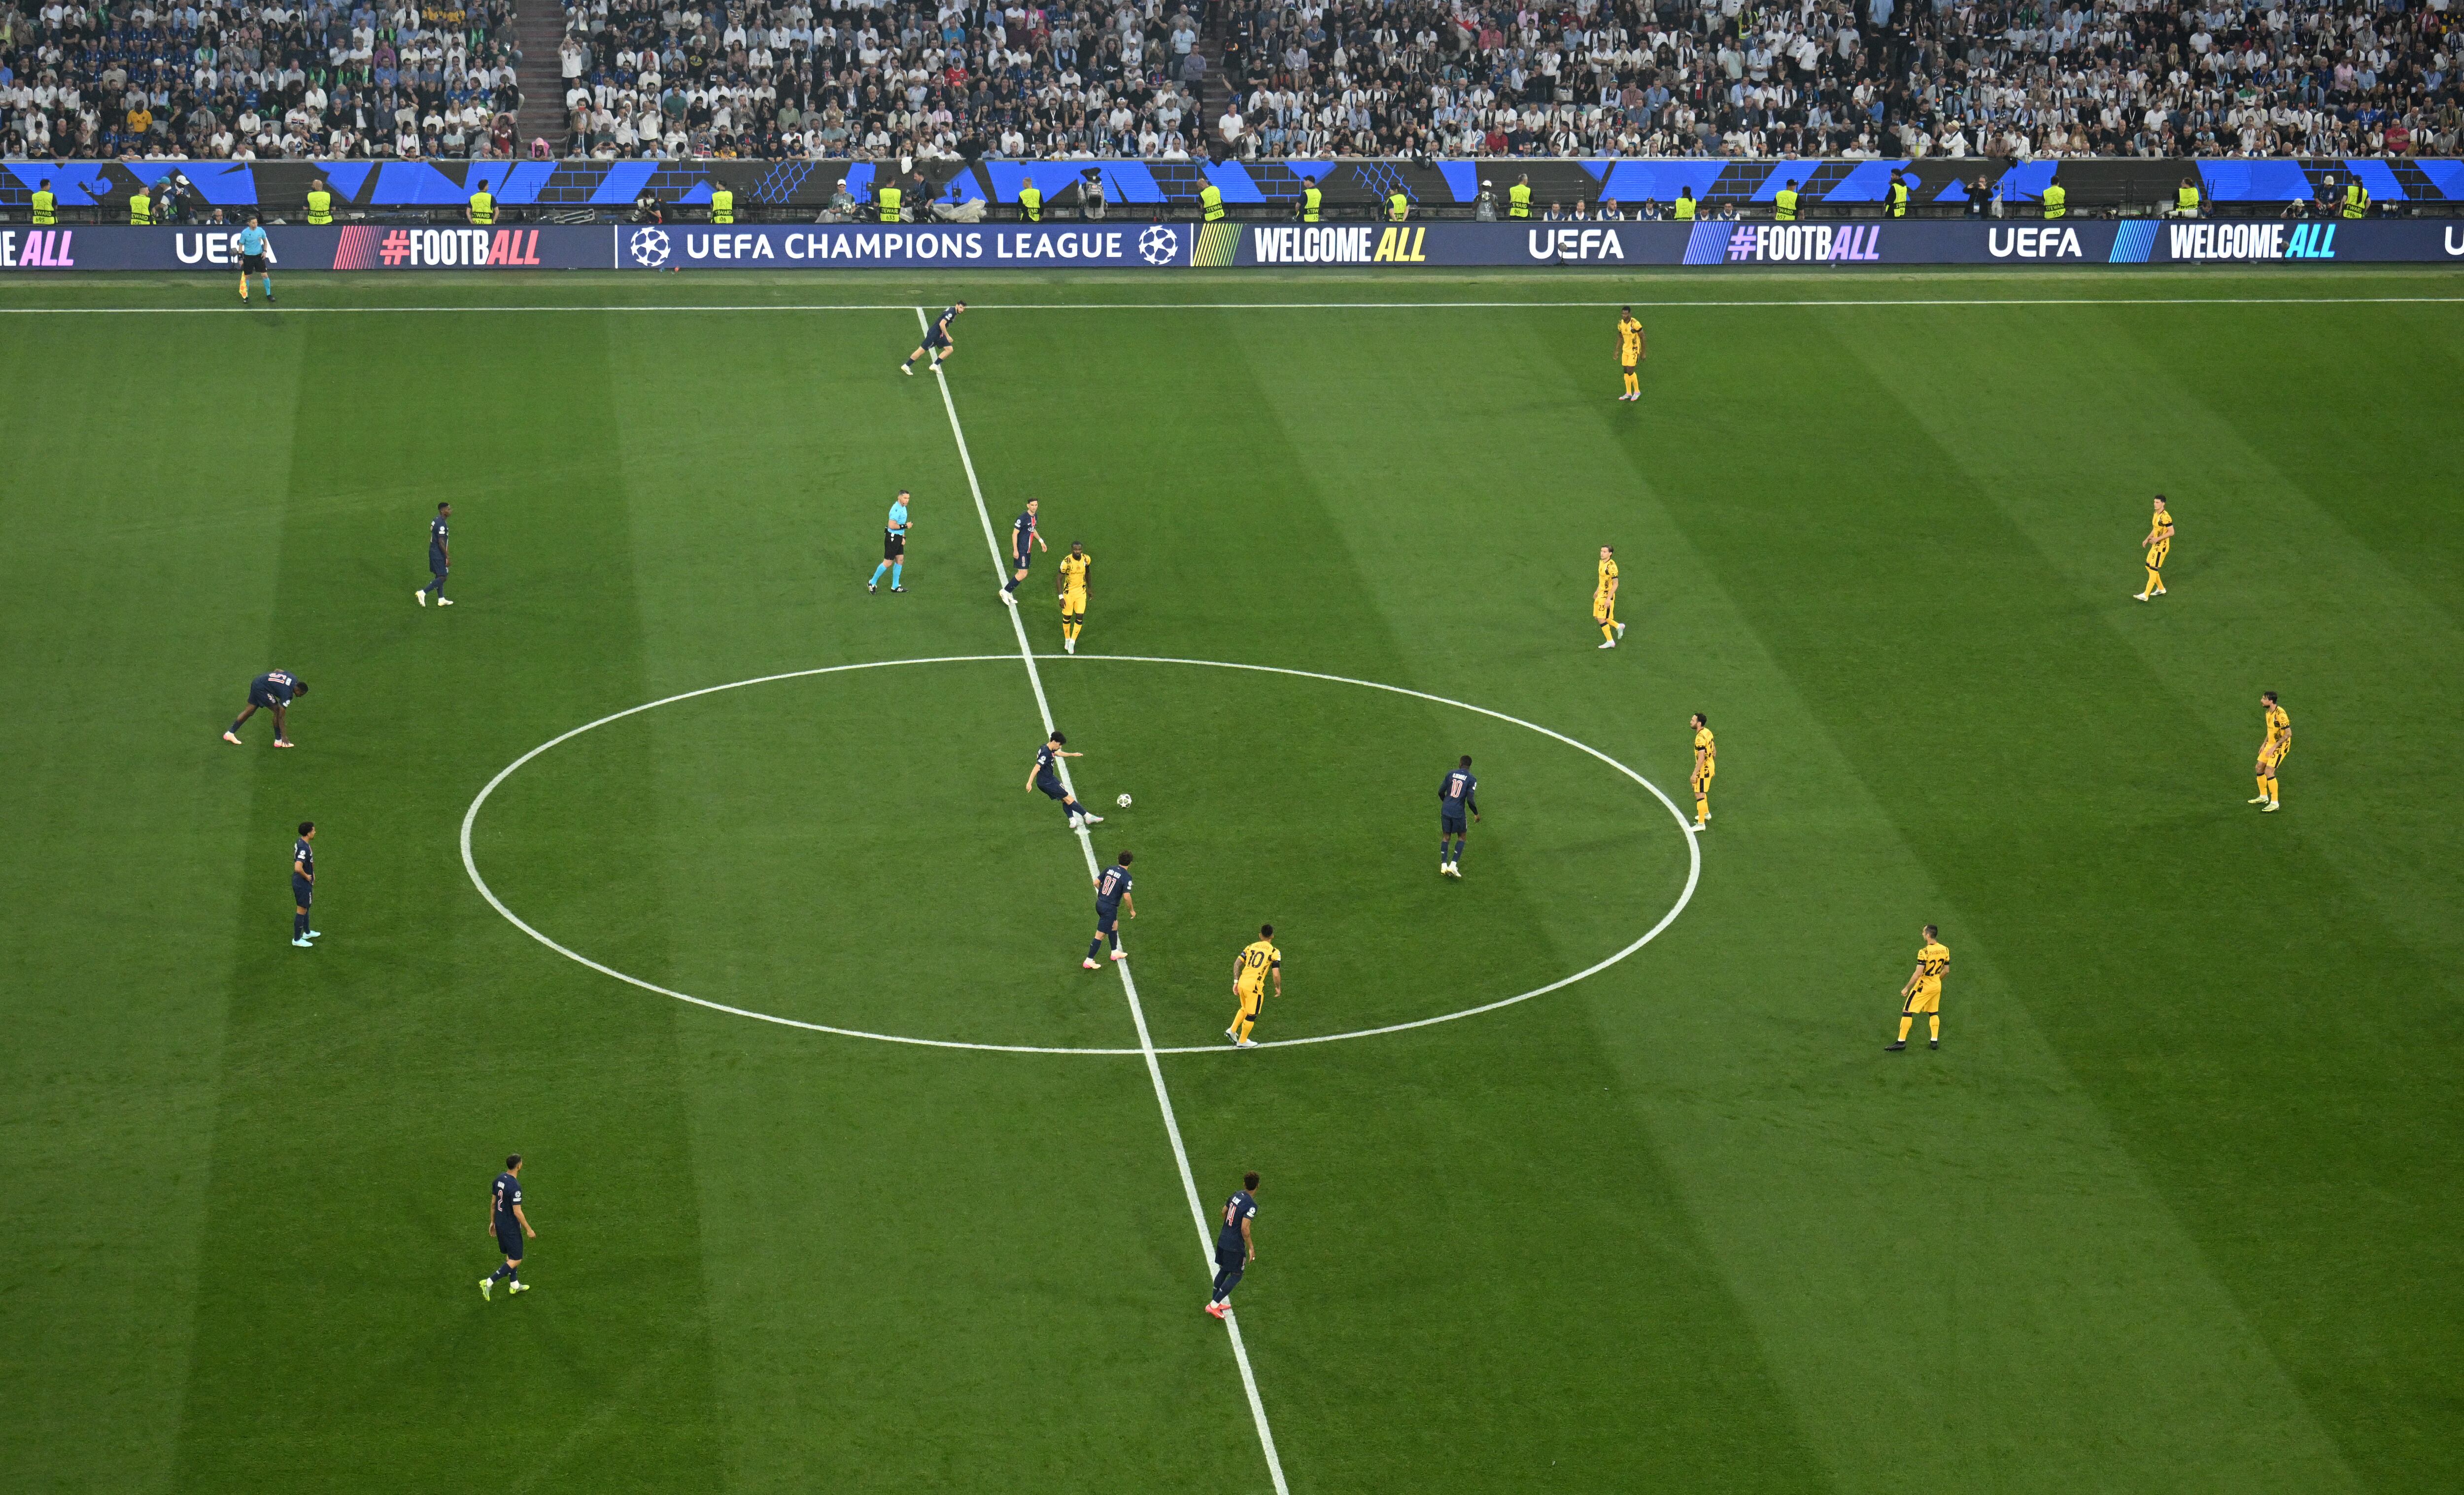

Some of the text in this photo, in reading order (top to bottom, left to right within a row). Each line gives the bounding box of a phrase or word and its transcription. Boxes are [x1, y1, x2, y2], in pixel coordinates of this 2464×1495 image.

[0, 230, 73, 266] E ALL
[380, 229, 540, 265] #FOOTBALL
[687, 233, 1122, 259] UEFA CHAMPIONS LEAGUE
[1255, 227, 1425, 262] WELCOME ALL
[1529, 229, 1624, 259] UEFA
[1728, 225, 1881, 261] #FOOTBALL
[1989, 228, 2082, 257] UEFA
[2170, 223, 2336, 258] WELCOME ALL
[1450, 778, 1463, 798] 10
[1102, 875, 1117, 896] 87
[1247, 949, 1265, 968] 10
[1925, 958, 1945, 976] 22
[498, 1189, 503, 1212] 2
[1226, 1202, 1237, 1227] 14
